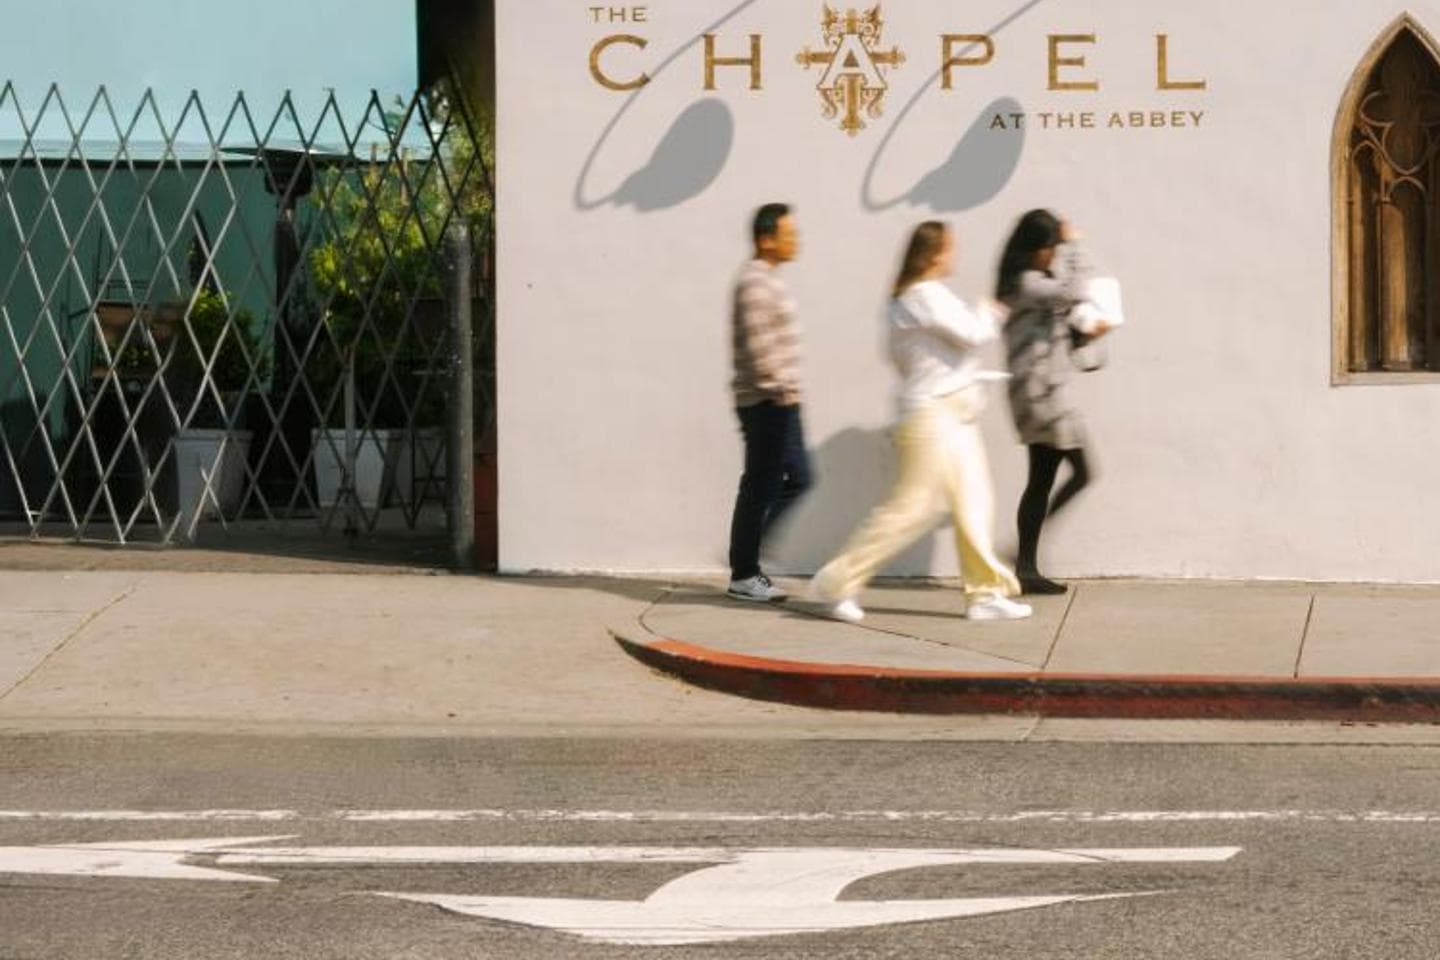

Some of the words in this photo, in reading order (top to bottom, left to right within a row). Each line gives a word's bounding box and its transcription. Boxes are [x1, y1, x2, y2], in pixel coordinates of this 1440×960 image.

[589, 7, 647, 22] THE
[589, 34, 1206, 91] CHAPEL
[990, 113, 1024, 130] AT
[1039, 112, 1094, 128] THE
[1108, 111, 1204, 128] ABBEY
